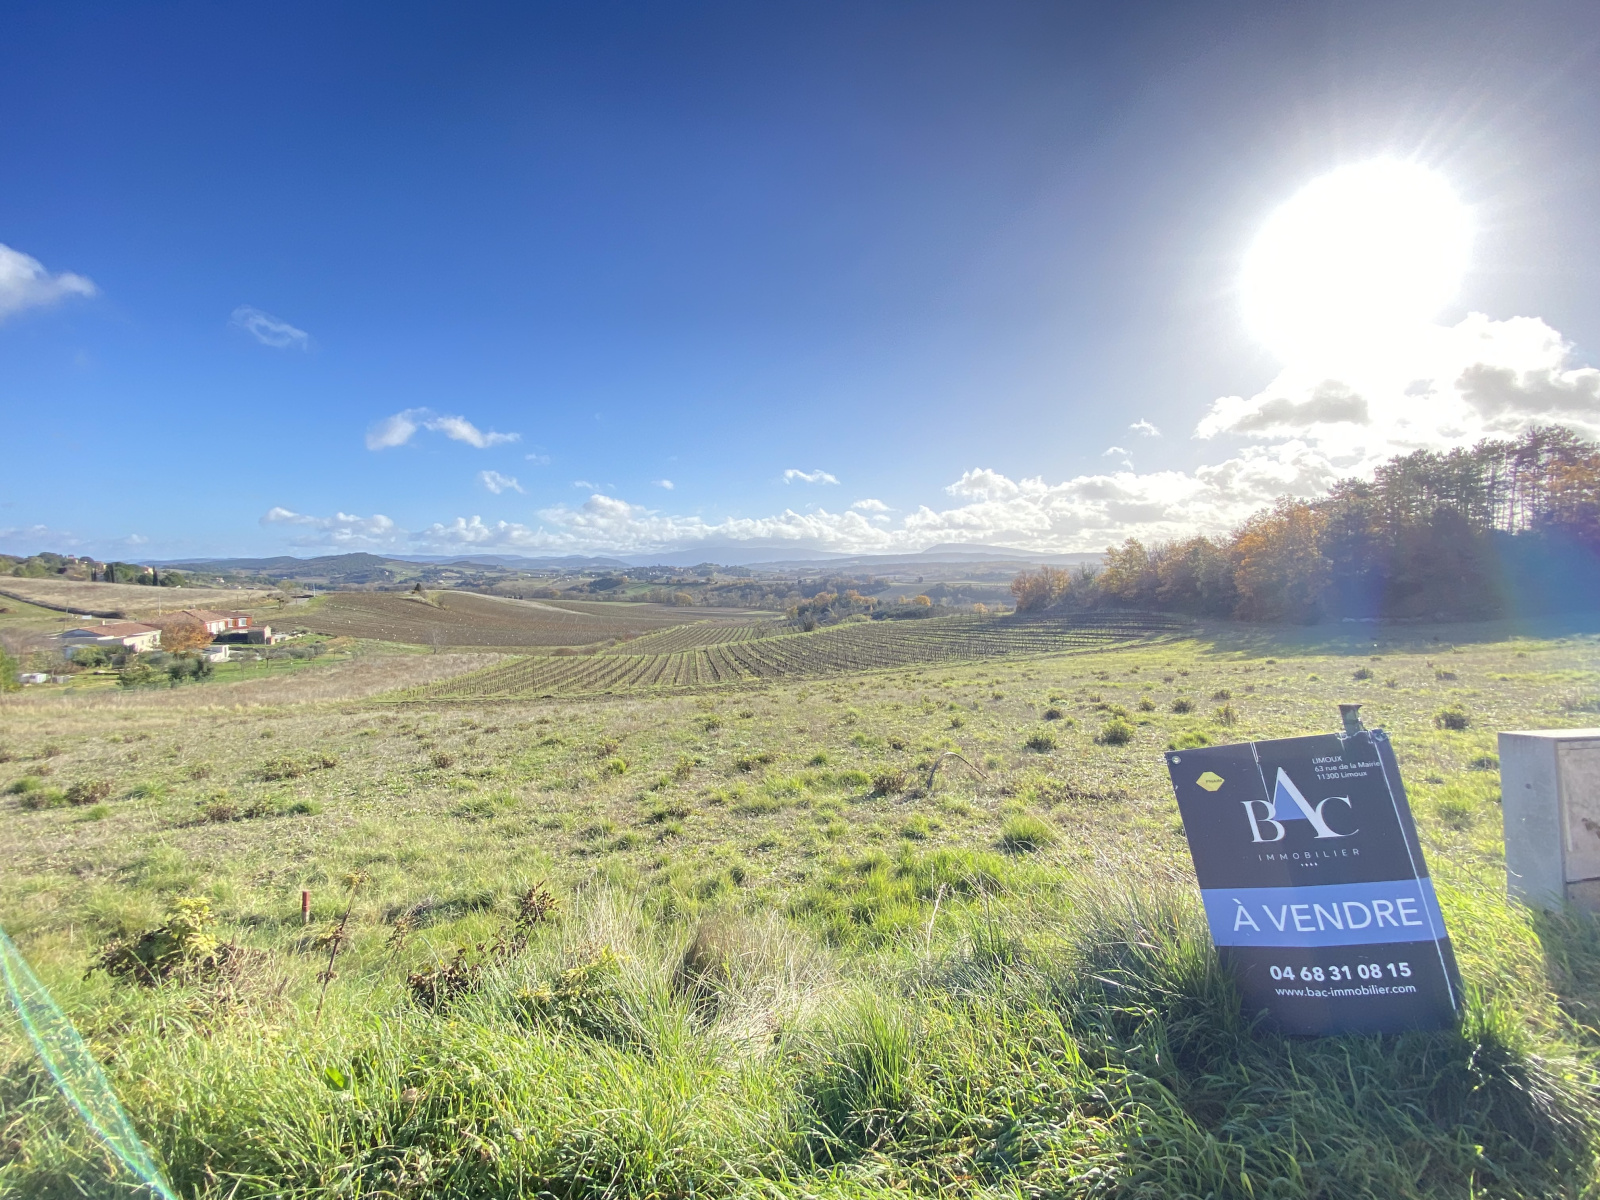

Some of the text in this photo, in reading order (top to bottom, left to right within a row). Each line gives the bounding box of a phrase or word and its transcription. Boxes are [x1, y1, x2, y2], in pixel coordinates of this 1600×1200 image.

[1312, 755, 1342, 764] LIMOUX
[1317, 771, 1367, 780] 11300 Limoux
[1241, 766, 1359, 842] BAC
[1258, 848, 1360, 861] IMMOBILIER
[1232, 898, 1423, 932] À VENDRE
[1270, 962, 1412, 982] 04 68 31 08 15
[1275, 983, 1416, 998] www.bac-immobilier.com
